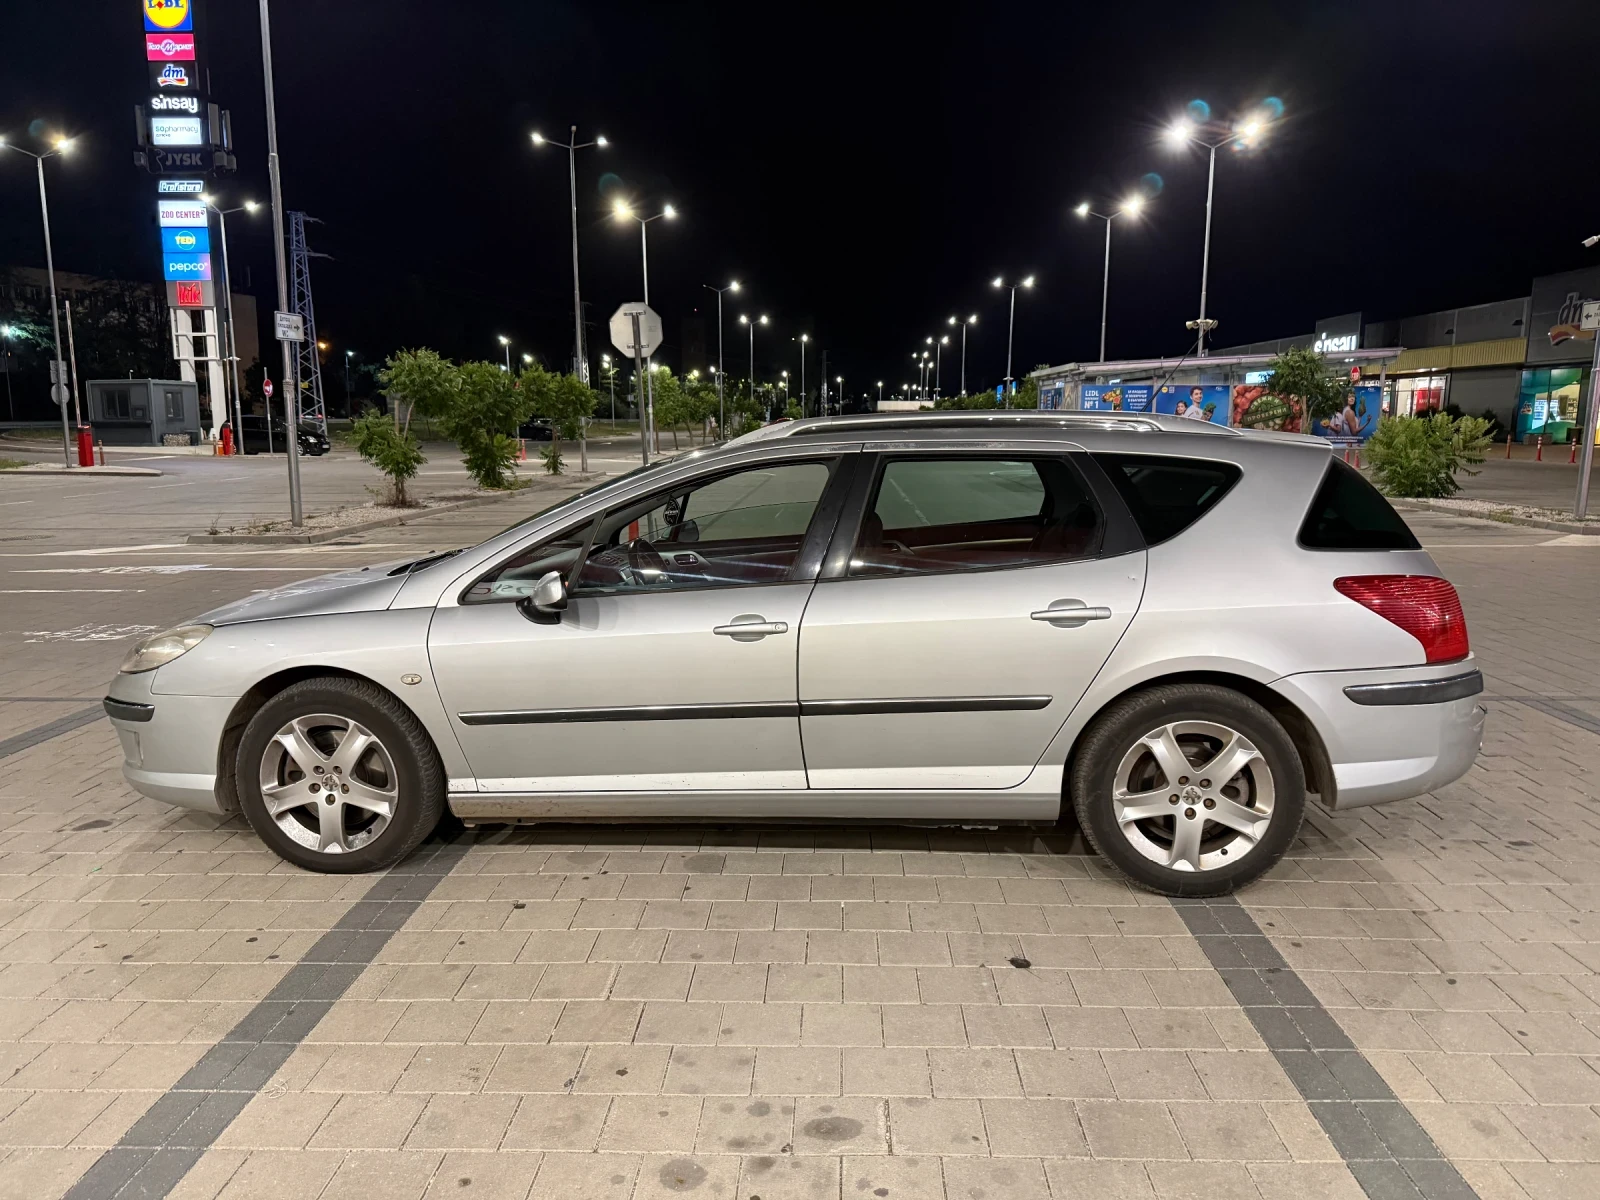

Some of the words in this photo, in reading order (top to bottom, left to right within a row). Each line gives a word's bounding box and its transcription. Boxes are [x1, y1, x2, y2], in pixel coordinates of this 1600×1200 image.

[163, 65, 184, 78] dm
[151, 94, 198, 113] sinsay
[165, 153, 202, 165] JYSK
[169, 262, 205, 272] pepco
[1094, 401, 1099, 409] 1
